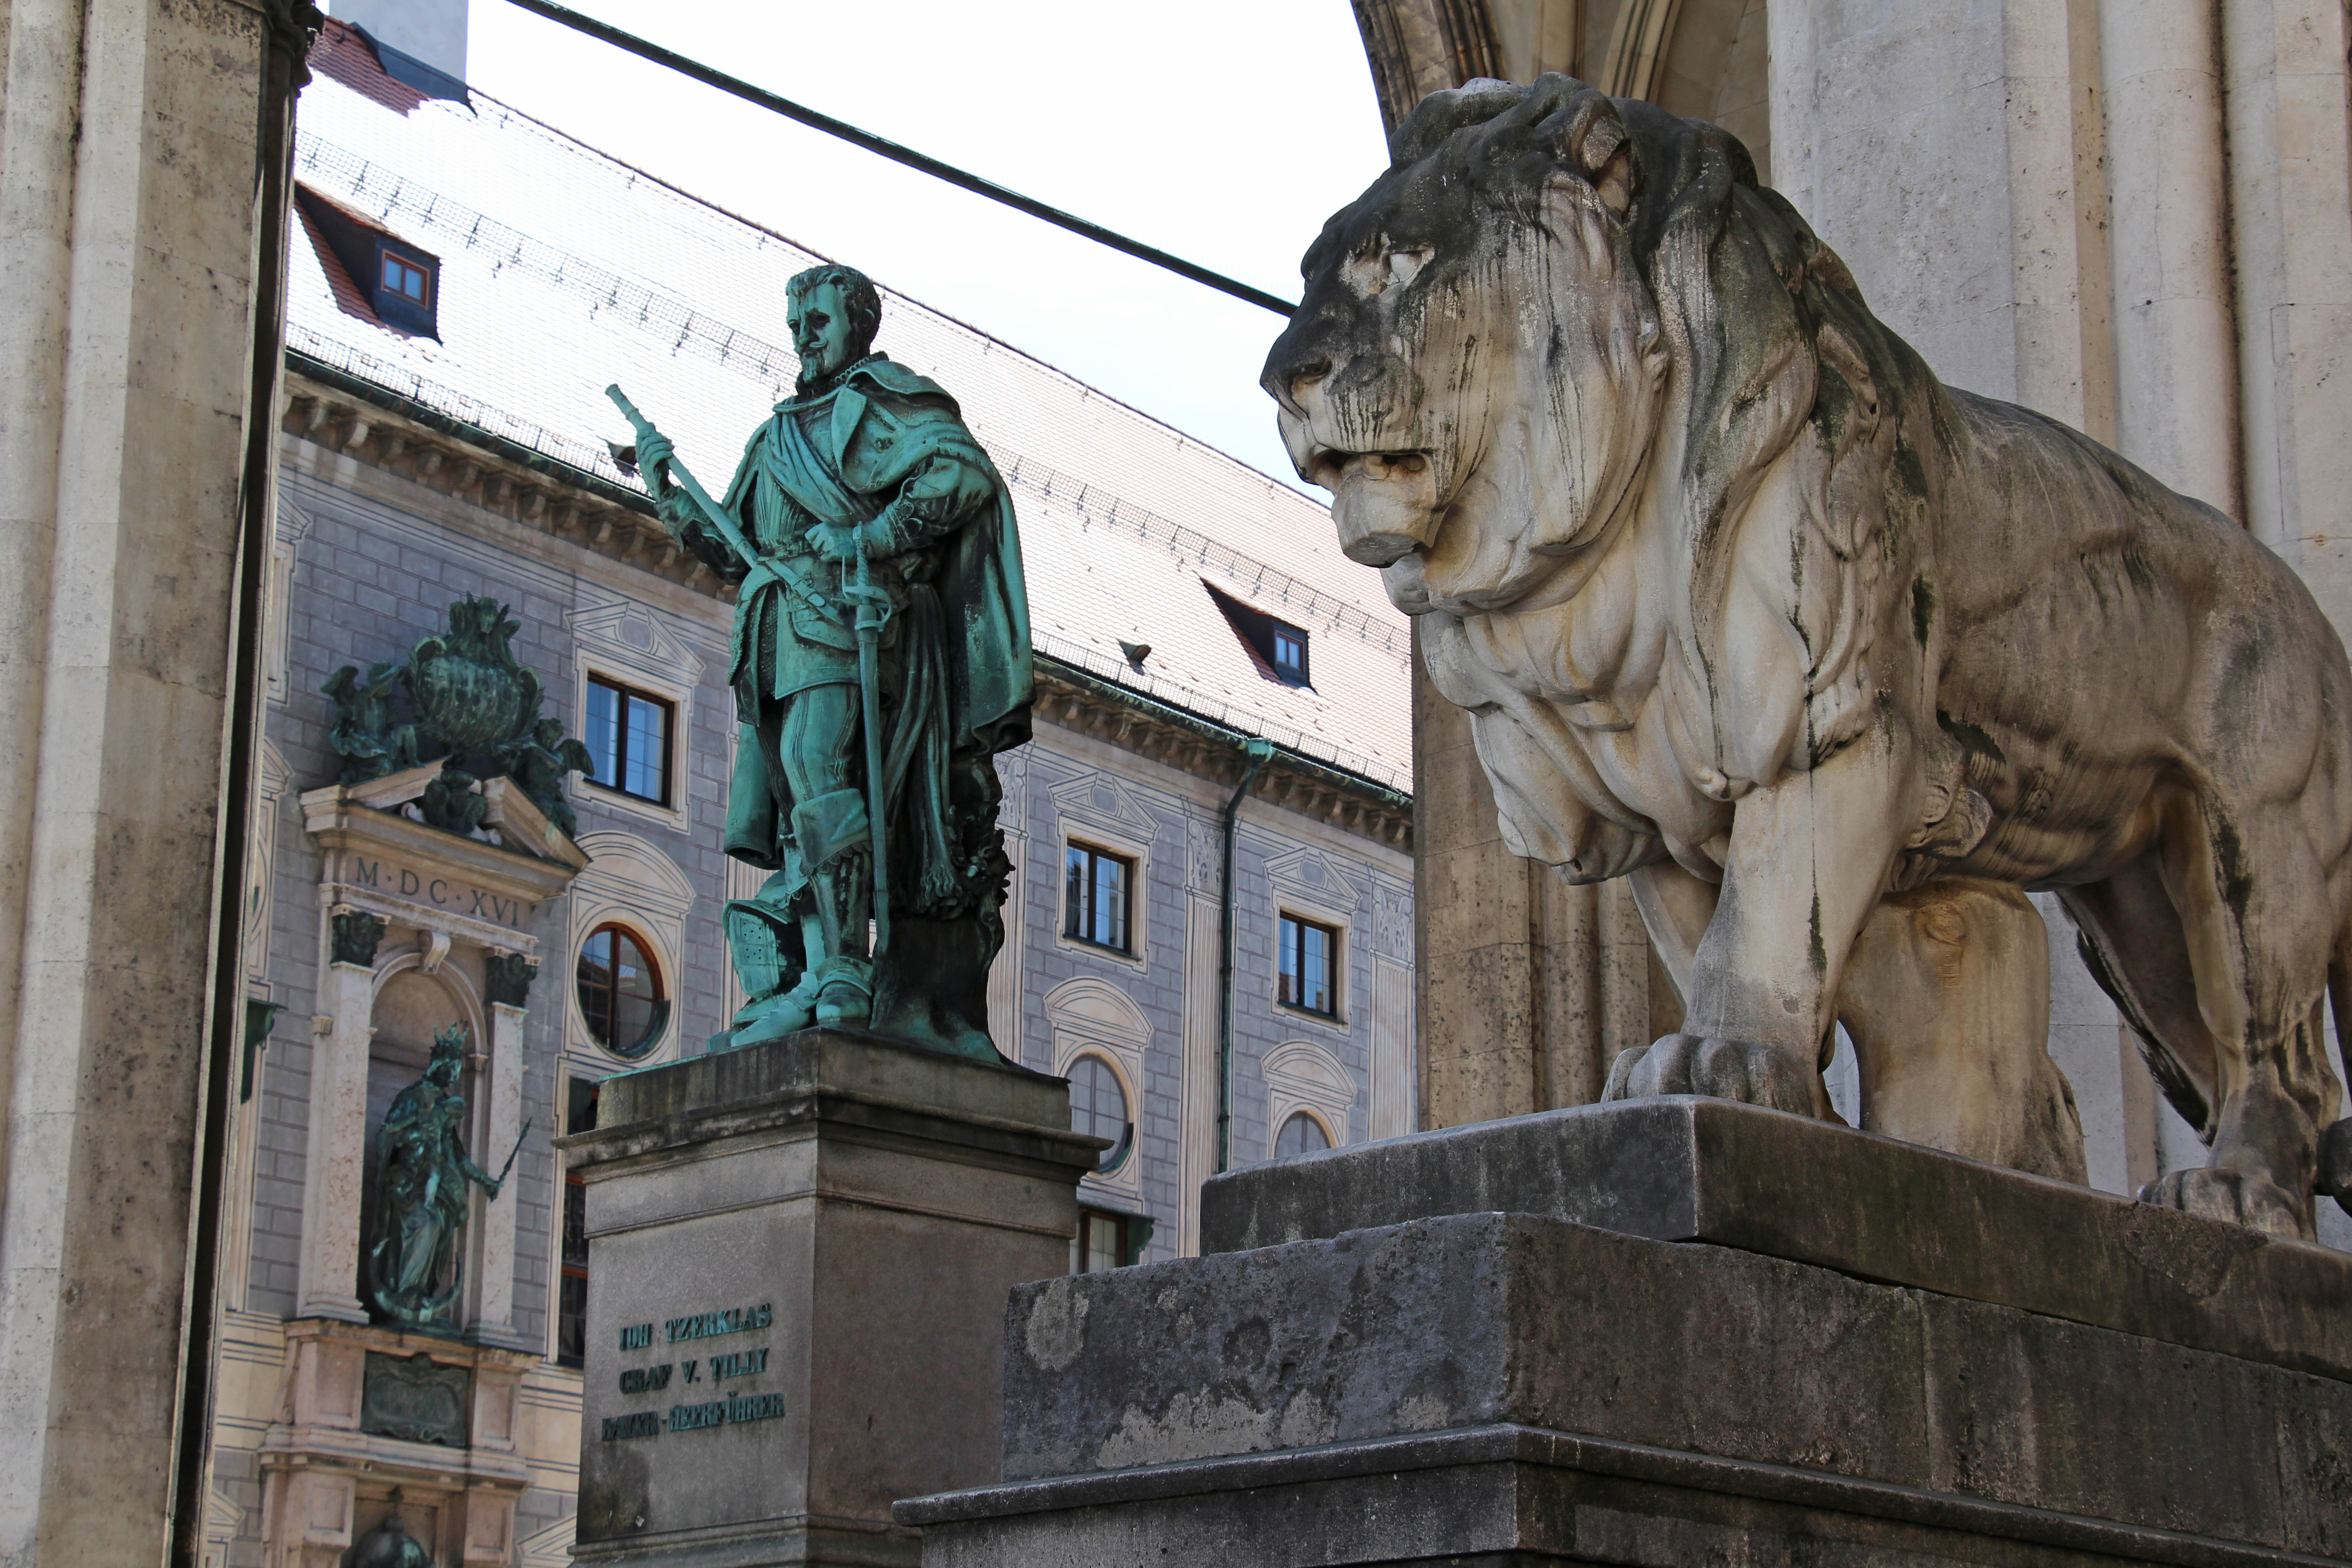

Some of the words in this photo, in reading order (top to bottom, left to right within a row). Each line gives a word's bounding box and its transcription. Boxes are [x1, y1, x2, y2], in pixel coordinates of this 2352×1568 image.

[664, 1303, 771, 1343] TZERKLAS
[681, 1360, 701, 1384] V.
[710, 1348, 769, 1380] TILLY
